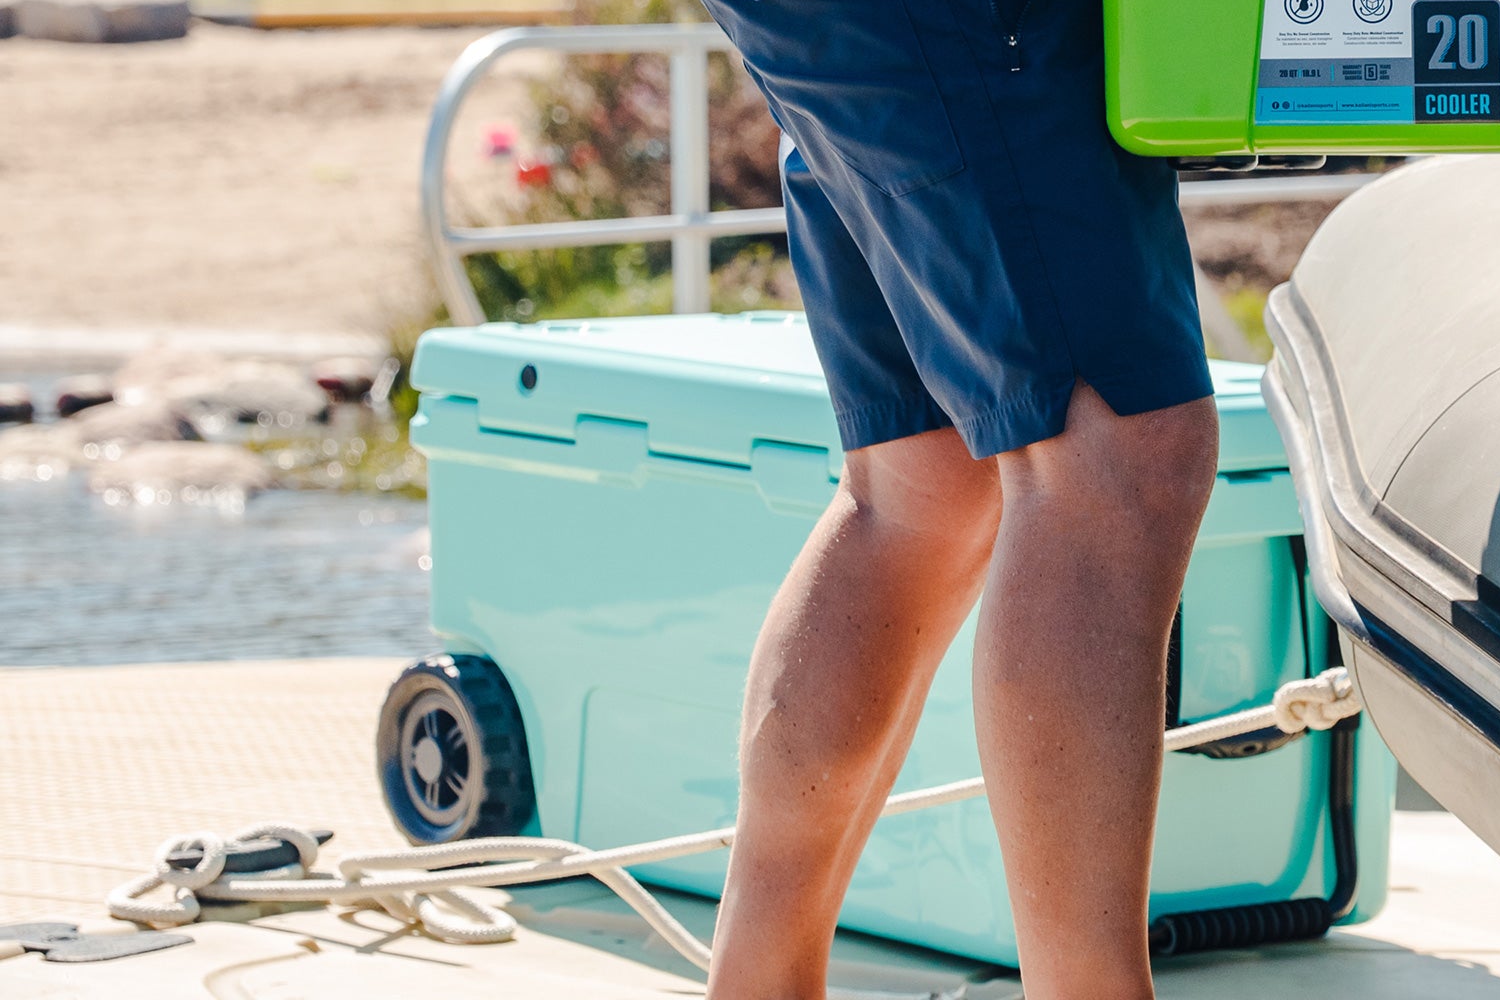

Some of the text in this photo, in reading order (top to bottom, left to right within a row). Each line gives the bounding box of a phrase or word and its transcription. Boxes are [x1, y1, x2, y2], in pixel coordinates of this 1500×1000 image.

[1426, 14, 1489, 71] 20
[1289, 69, 1298, 78] QT
[1367, 66, 1375, 78] 5
[1425, 94, 1491, 116] COOLER
